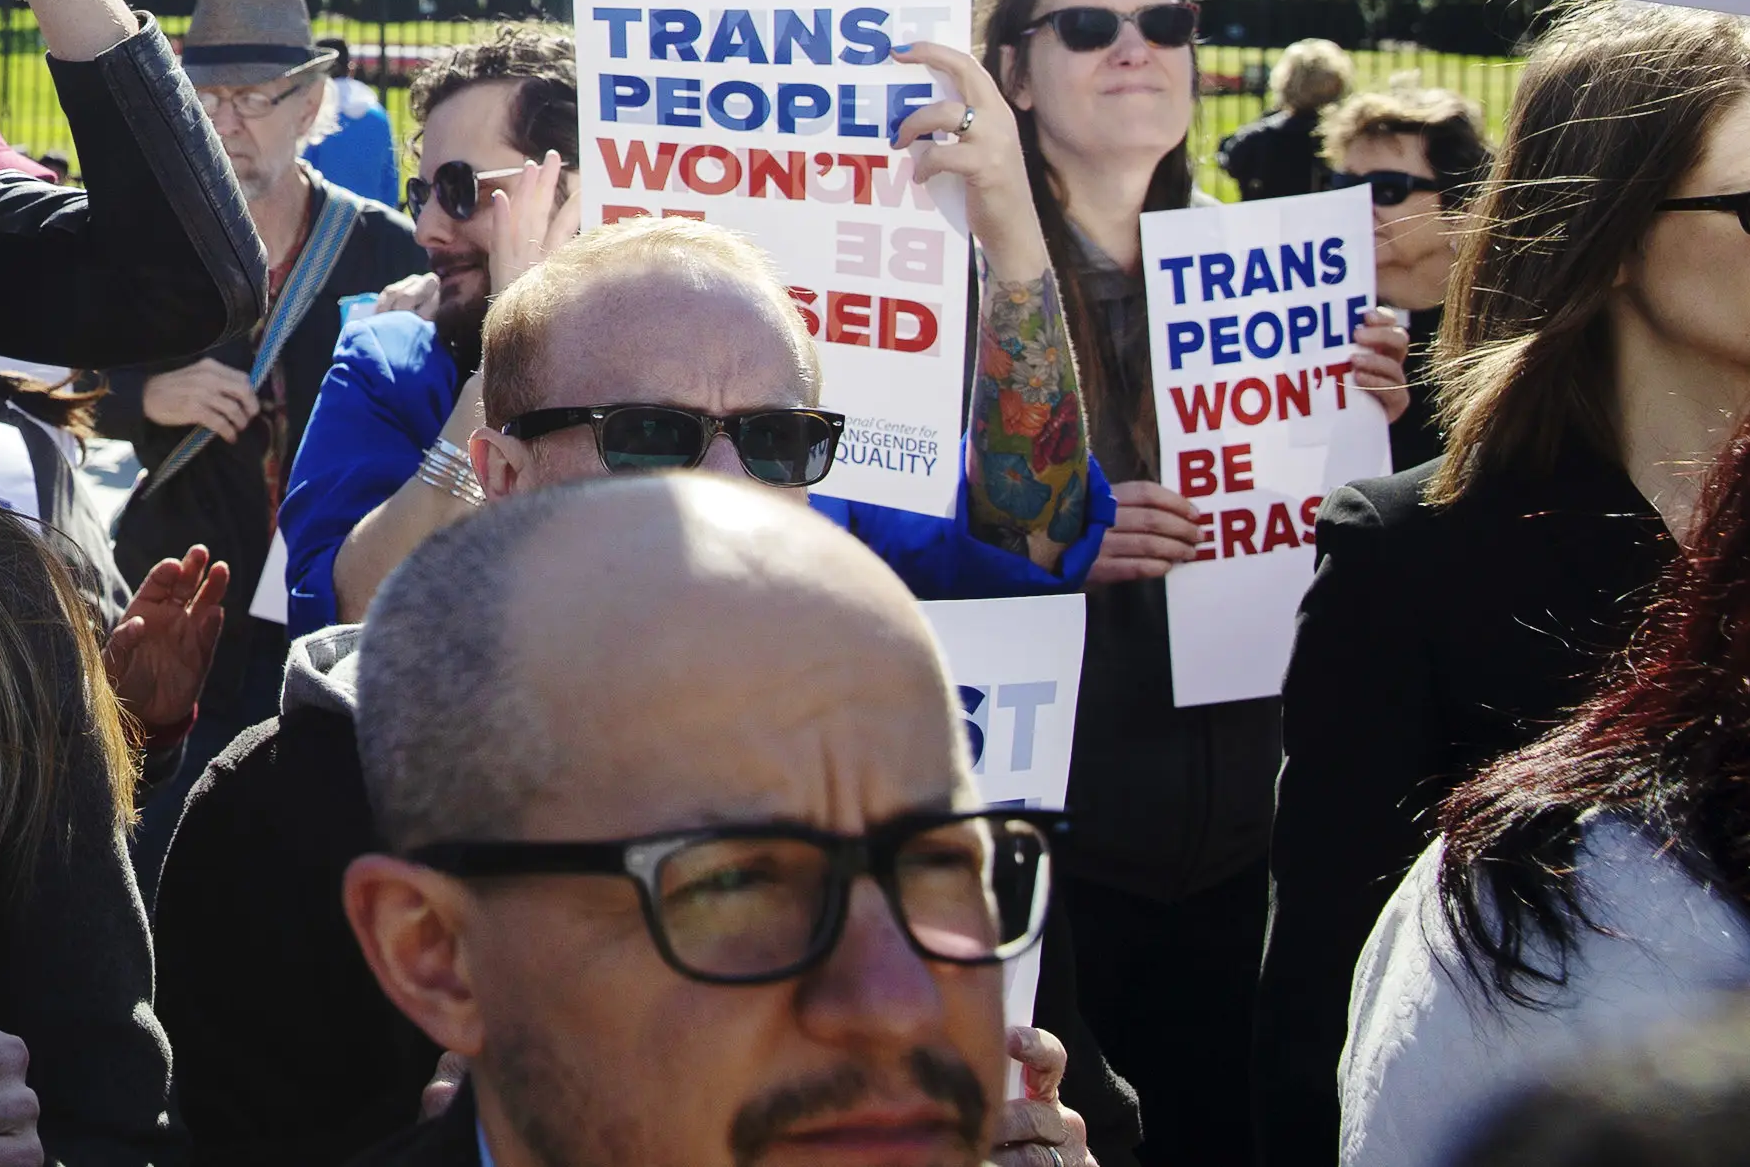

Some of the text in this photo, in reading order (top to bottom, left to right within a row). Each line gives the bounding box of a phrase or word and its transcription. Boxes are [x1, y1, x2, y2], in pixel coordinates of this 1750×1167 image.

[593, 7, 892, 66] TRANS
[599, 73, 934, 141] PEOPLE
[596, 137, 890, 205] WON'T
[1159, 237, 1348, 305] TRANS
[875, 419, 917, 435] Center
[919, 425, 938, 439] for
[1169, 362, 1353, 434] WON'T
[1177, 444, 1255, 498] BE
